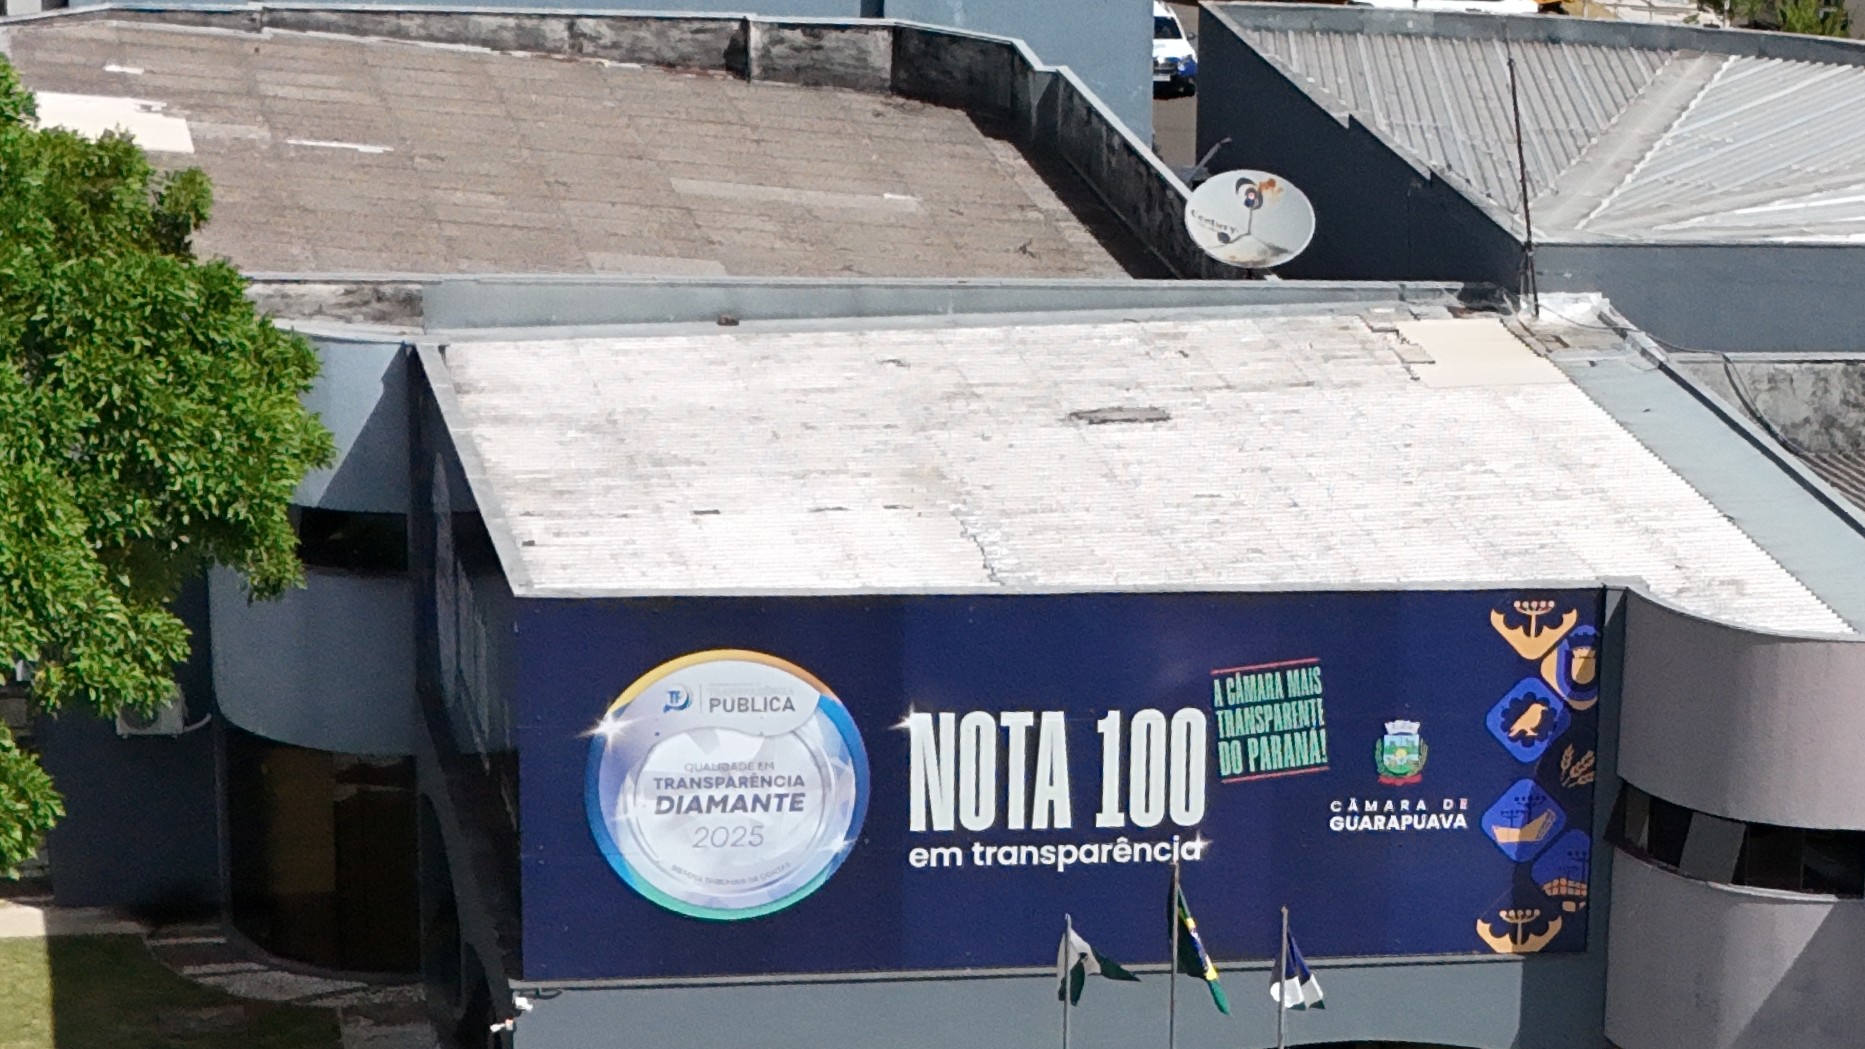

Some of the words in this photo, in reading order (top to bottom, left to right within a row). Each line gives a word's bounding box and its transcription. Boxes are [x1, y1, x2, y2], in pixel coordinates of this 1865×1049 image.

[1213, 678, 1224, 708] A
[1286, 665, 1323, 698] MAIS
[1215, 697, 1325, 739] TRANSPARENTE
[684, 761, 755, 774] QUALIDADE
[757, 760, 776, 772] EM
[909, 710, 1072, 831] NOTA
[1095, 707, 1207, 828] 100
[1217, 739, 1243, 776] DO
[653, 772, 806, 790] TRANSPARÊNCIA
[654, 792, 807, 815] DIAMANTE
[1330, 797, 1427, 813] CÂMARA
[1442, 797, 1468, 811] DE
[1329, 813, 1468, 831] GUARAPUAVA
[692, 825, 765, 849] 2025
[908, 846, 963, 868] em
[971, 836, 1202, 872] transparência
